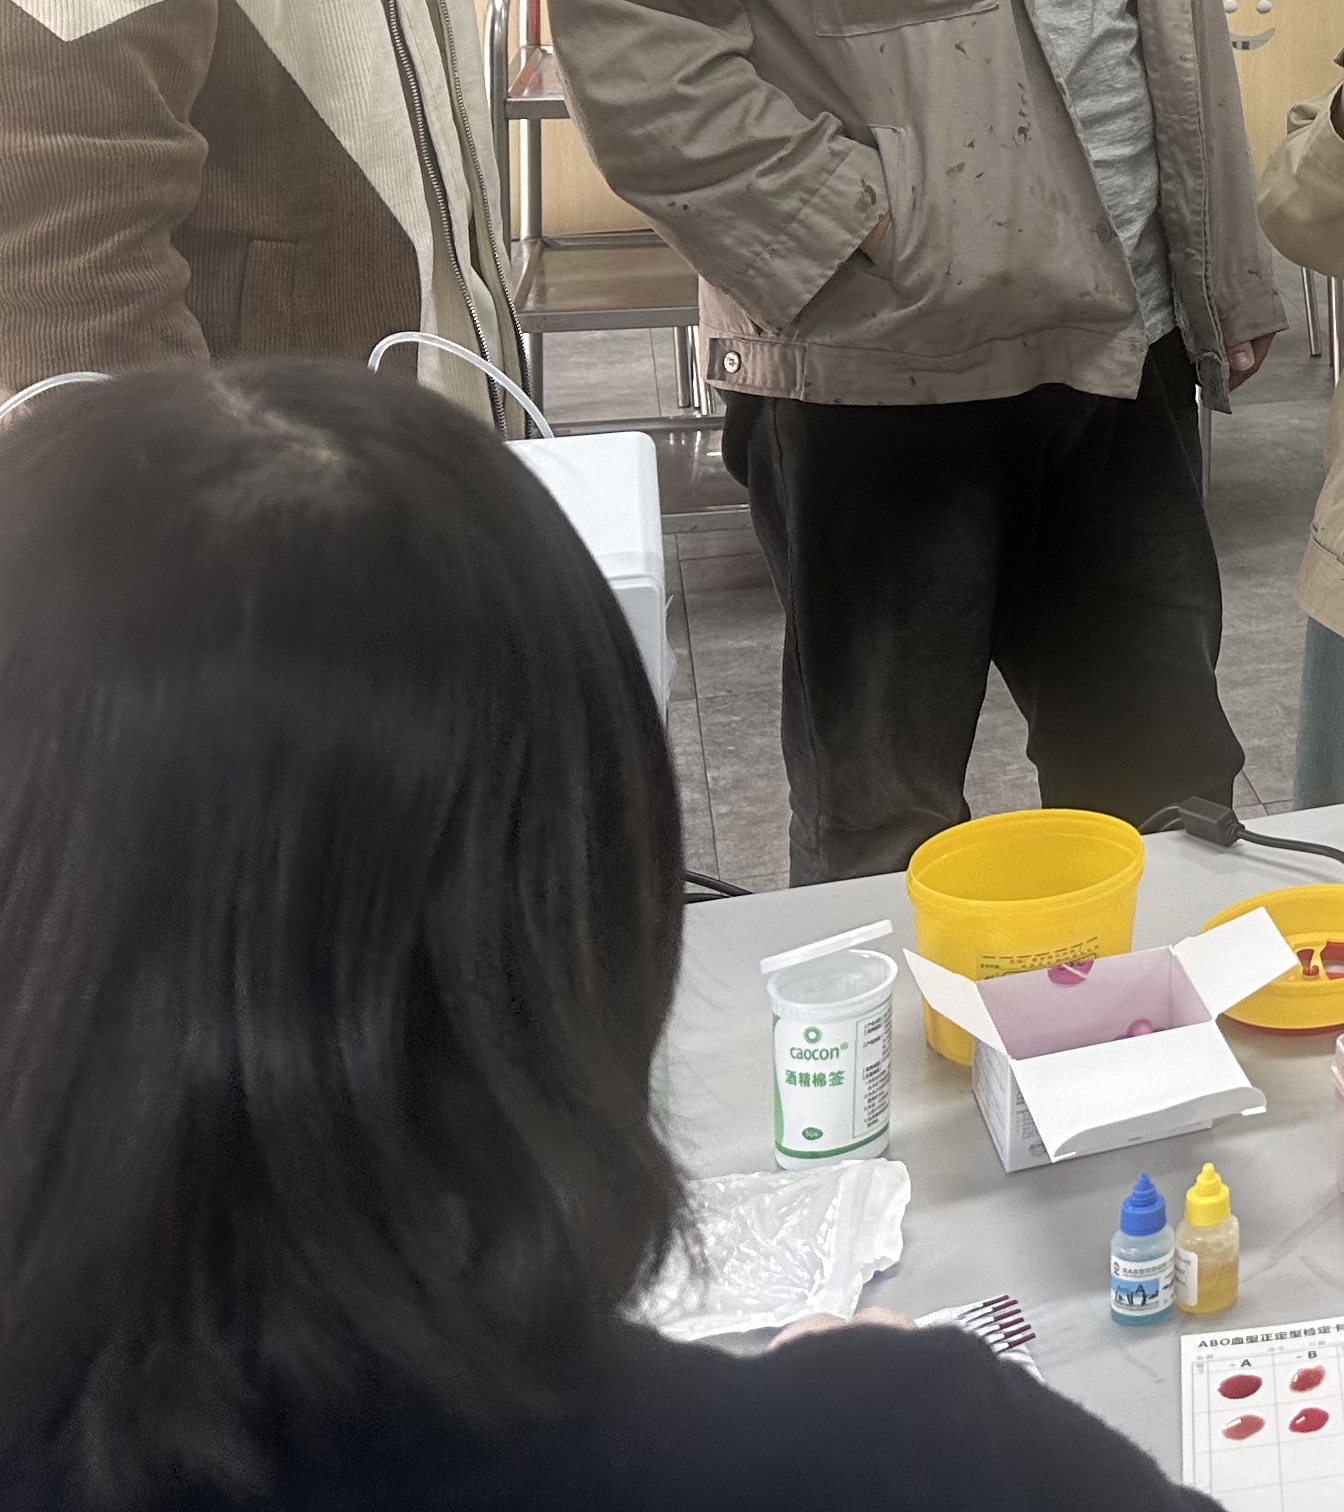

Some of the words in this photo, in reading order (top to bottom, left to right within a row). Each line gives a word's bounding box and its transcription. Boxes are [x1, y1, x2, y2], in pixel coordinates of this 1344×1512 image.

[789, 1046, 840, 1061] caocon
[785, 1069, 845, 1088] 酒精棉签
